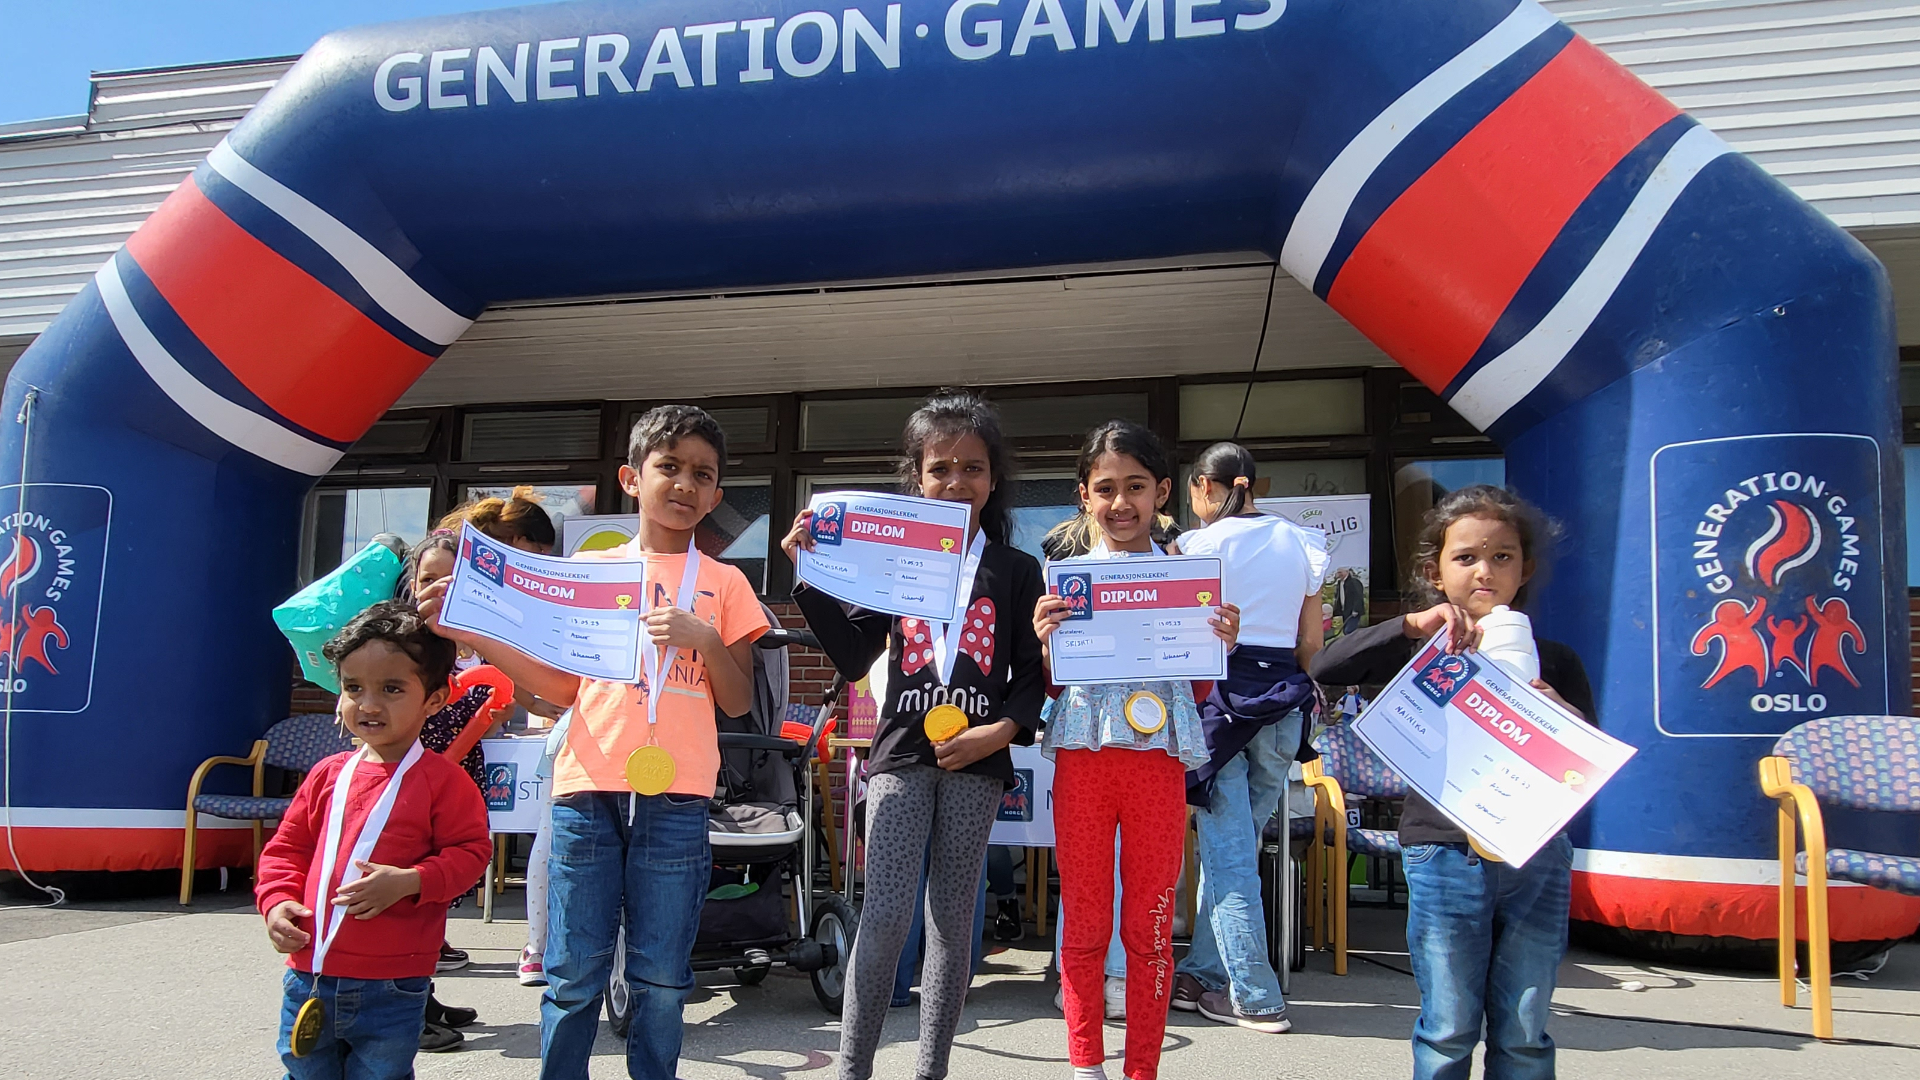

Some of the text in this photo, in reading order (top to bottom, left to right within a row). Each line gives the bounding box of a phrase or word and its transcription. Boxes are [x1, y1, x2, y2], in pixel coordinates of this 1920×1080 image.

[373, 3, 901, 112] GENERATION
[855, 505, 919, 519] GENERASJONSLEKENE
[851, 520, 905, 539] DIPLOM
[1693, 471, 1860, 594] GENERATION GAMES
[46, 529, 76, 602] GAMES
[515, 561, 591, 580] GENERASJONSLEKENE
[512, 573, 576, 600] DIPLOM
[1100, 571, 1170, 582] GENERASJONSLEKENE
[1100, 589, 1158, 604] DIPLOM
[1422, 680, 1443, 698] NORGE
[896, 682, 990, 718] minnie
[1485, 679, 1560, 735] GENERASJONSLEKENE
[1750, 693, 1828, 713] OSLO
[1394, 705, 1427, 735] NAINIKA
[1464, 692, 1533, 747] DIPLOM
[518, 780, 544, 801] ST
[1346, 810, 1359, 826] G
